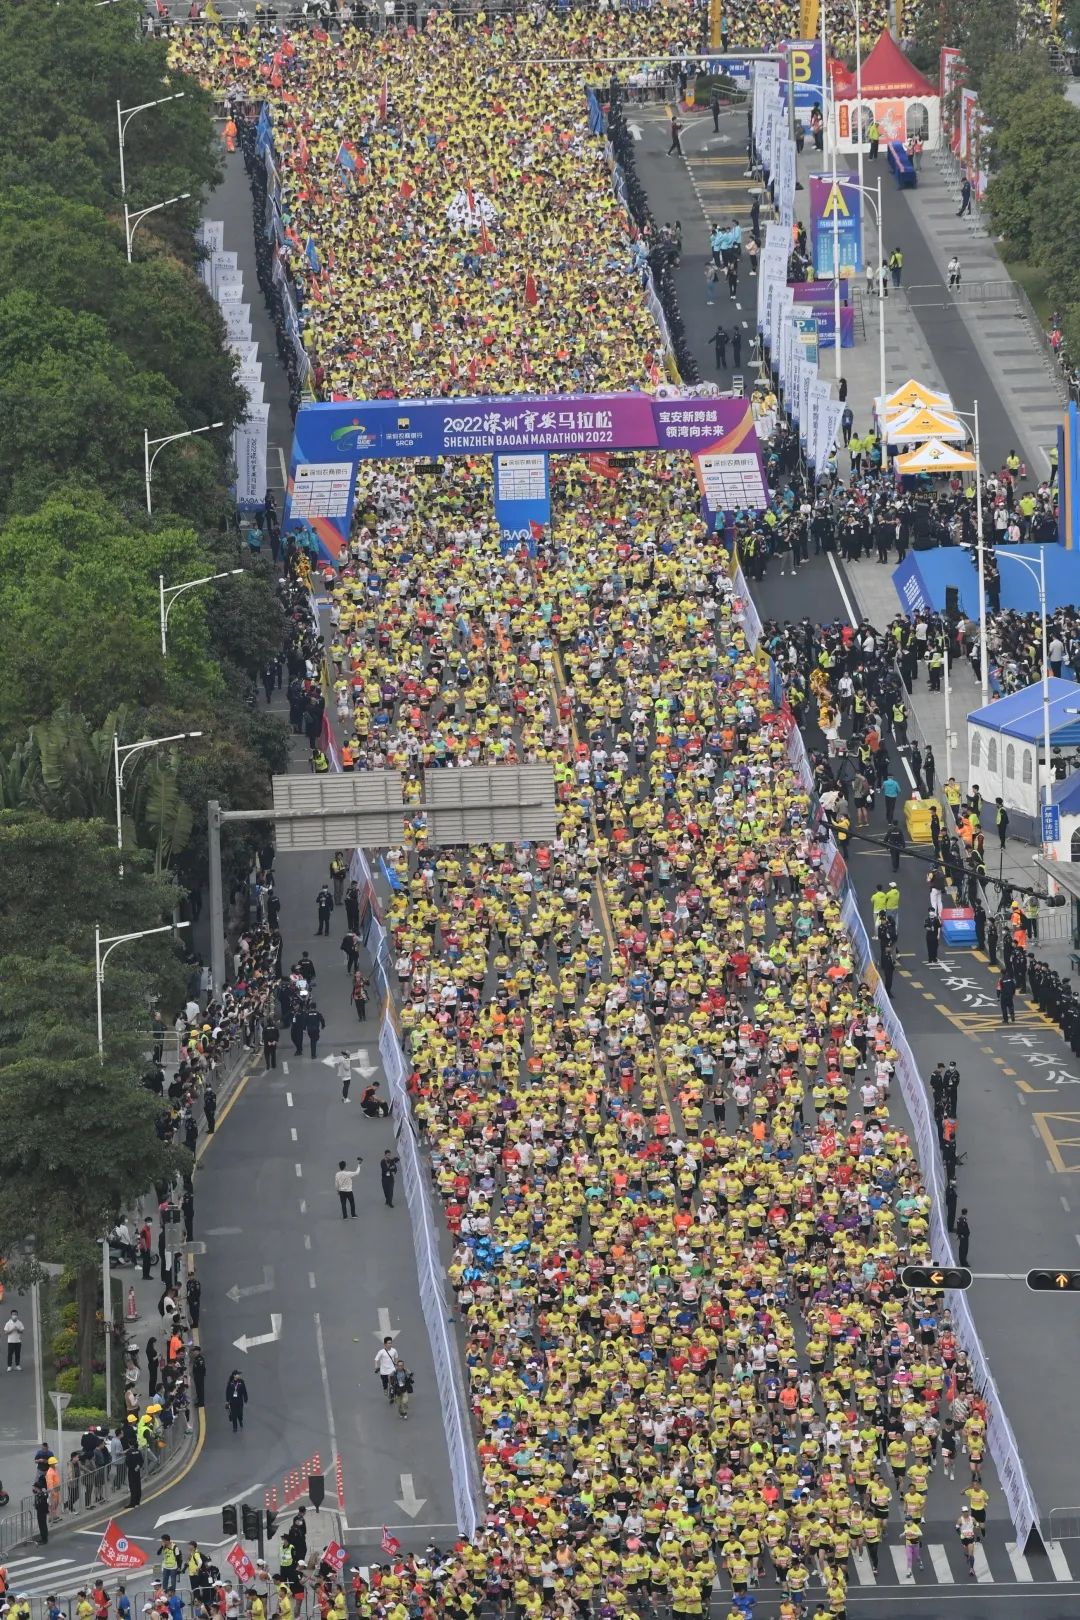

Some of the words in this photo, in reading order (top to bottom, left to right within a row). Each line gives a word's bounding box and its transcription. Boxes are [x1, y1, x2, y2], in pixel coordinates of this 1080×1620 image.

[791, 50, 812, 82] B
[822, 183, 850, 217] A
[659, 410, 718, 423] 宝安新跨越
[444, 435, 495, 448] SHENZHEN
[496, 433, 530, 446] BAOAN
[530, 432, 585, 445] MARATHON
[585, 431, 613, 443] 2022
[665, 425, 725, 438] 领湾向未来
